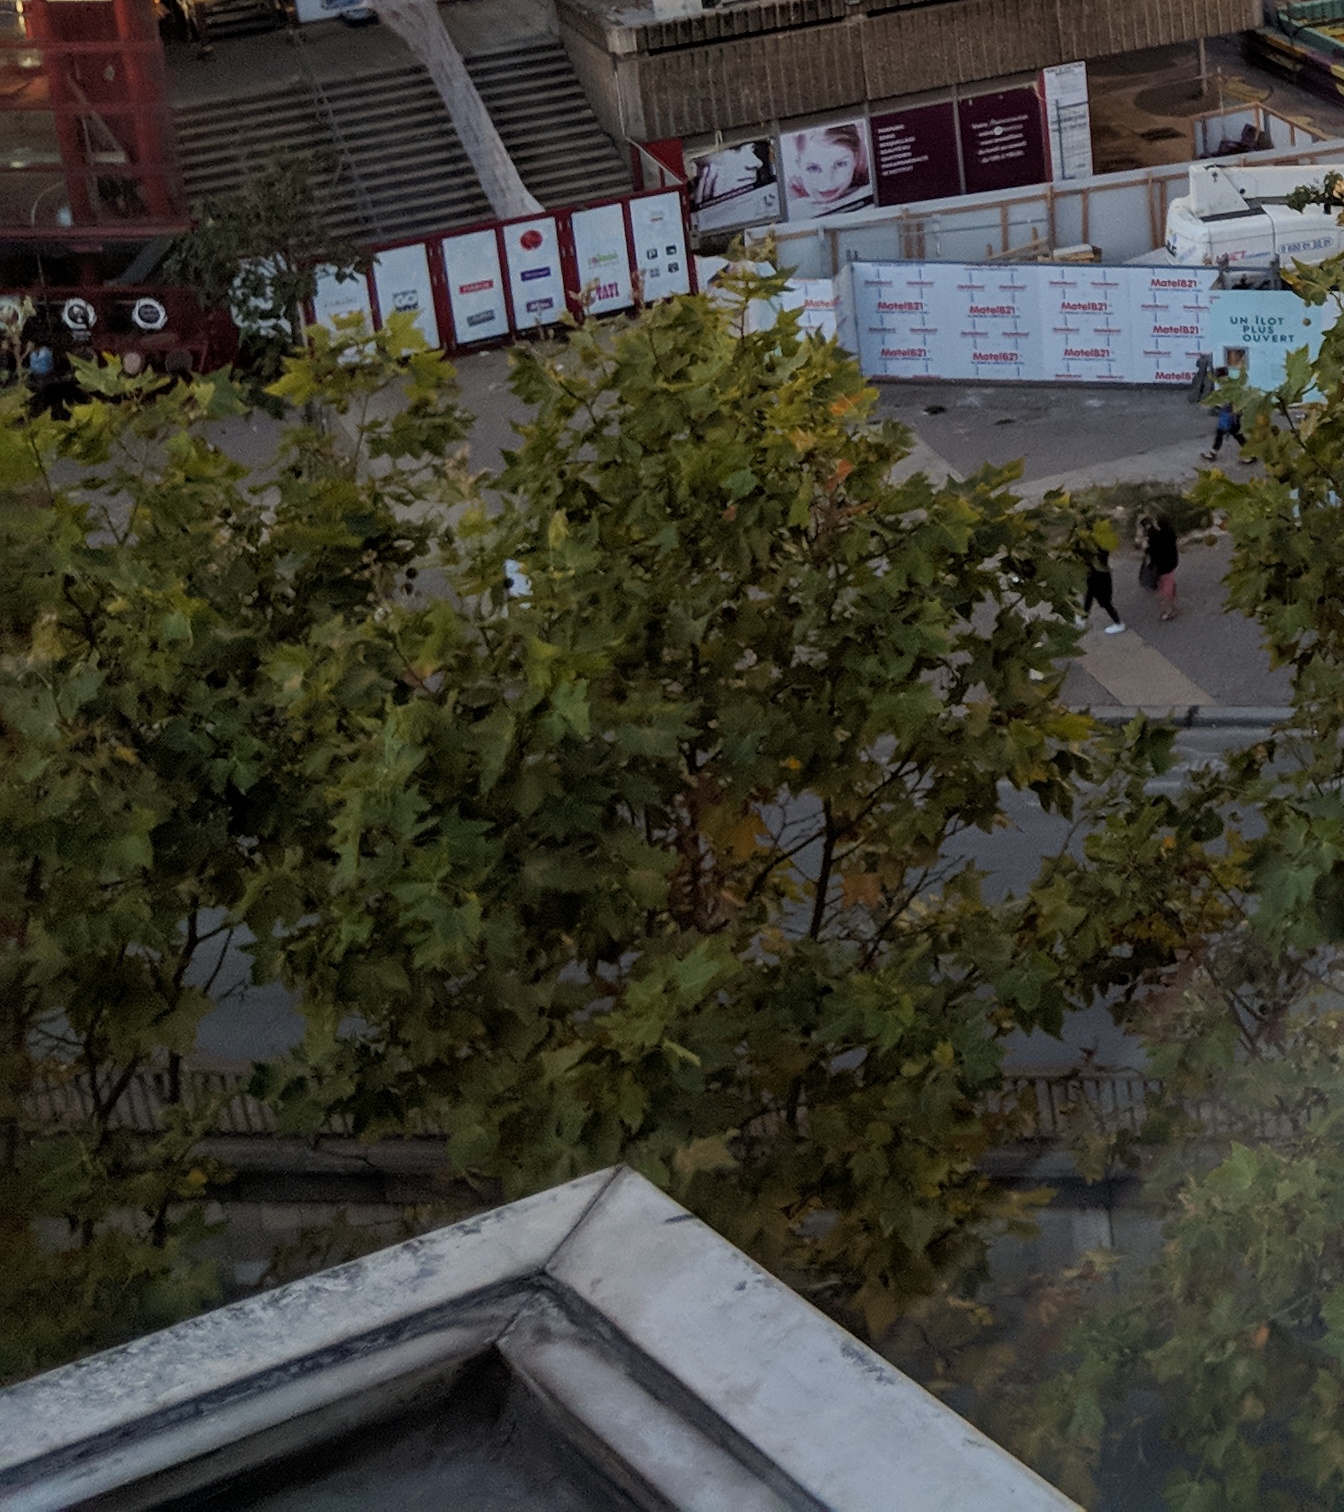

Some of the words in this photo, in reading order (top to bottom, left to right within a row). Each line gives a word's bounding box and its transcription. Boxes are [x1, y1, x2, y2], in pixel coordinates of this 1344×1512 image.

[1230, 316, 1248, 326] UN
[1255, 314, 1285, 326] ÎLOT
[1242, 325, 1275, 334] PLUS
[1242, 334, 1295, 343] OUVERT
